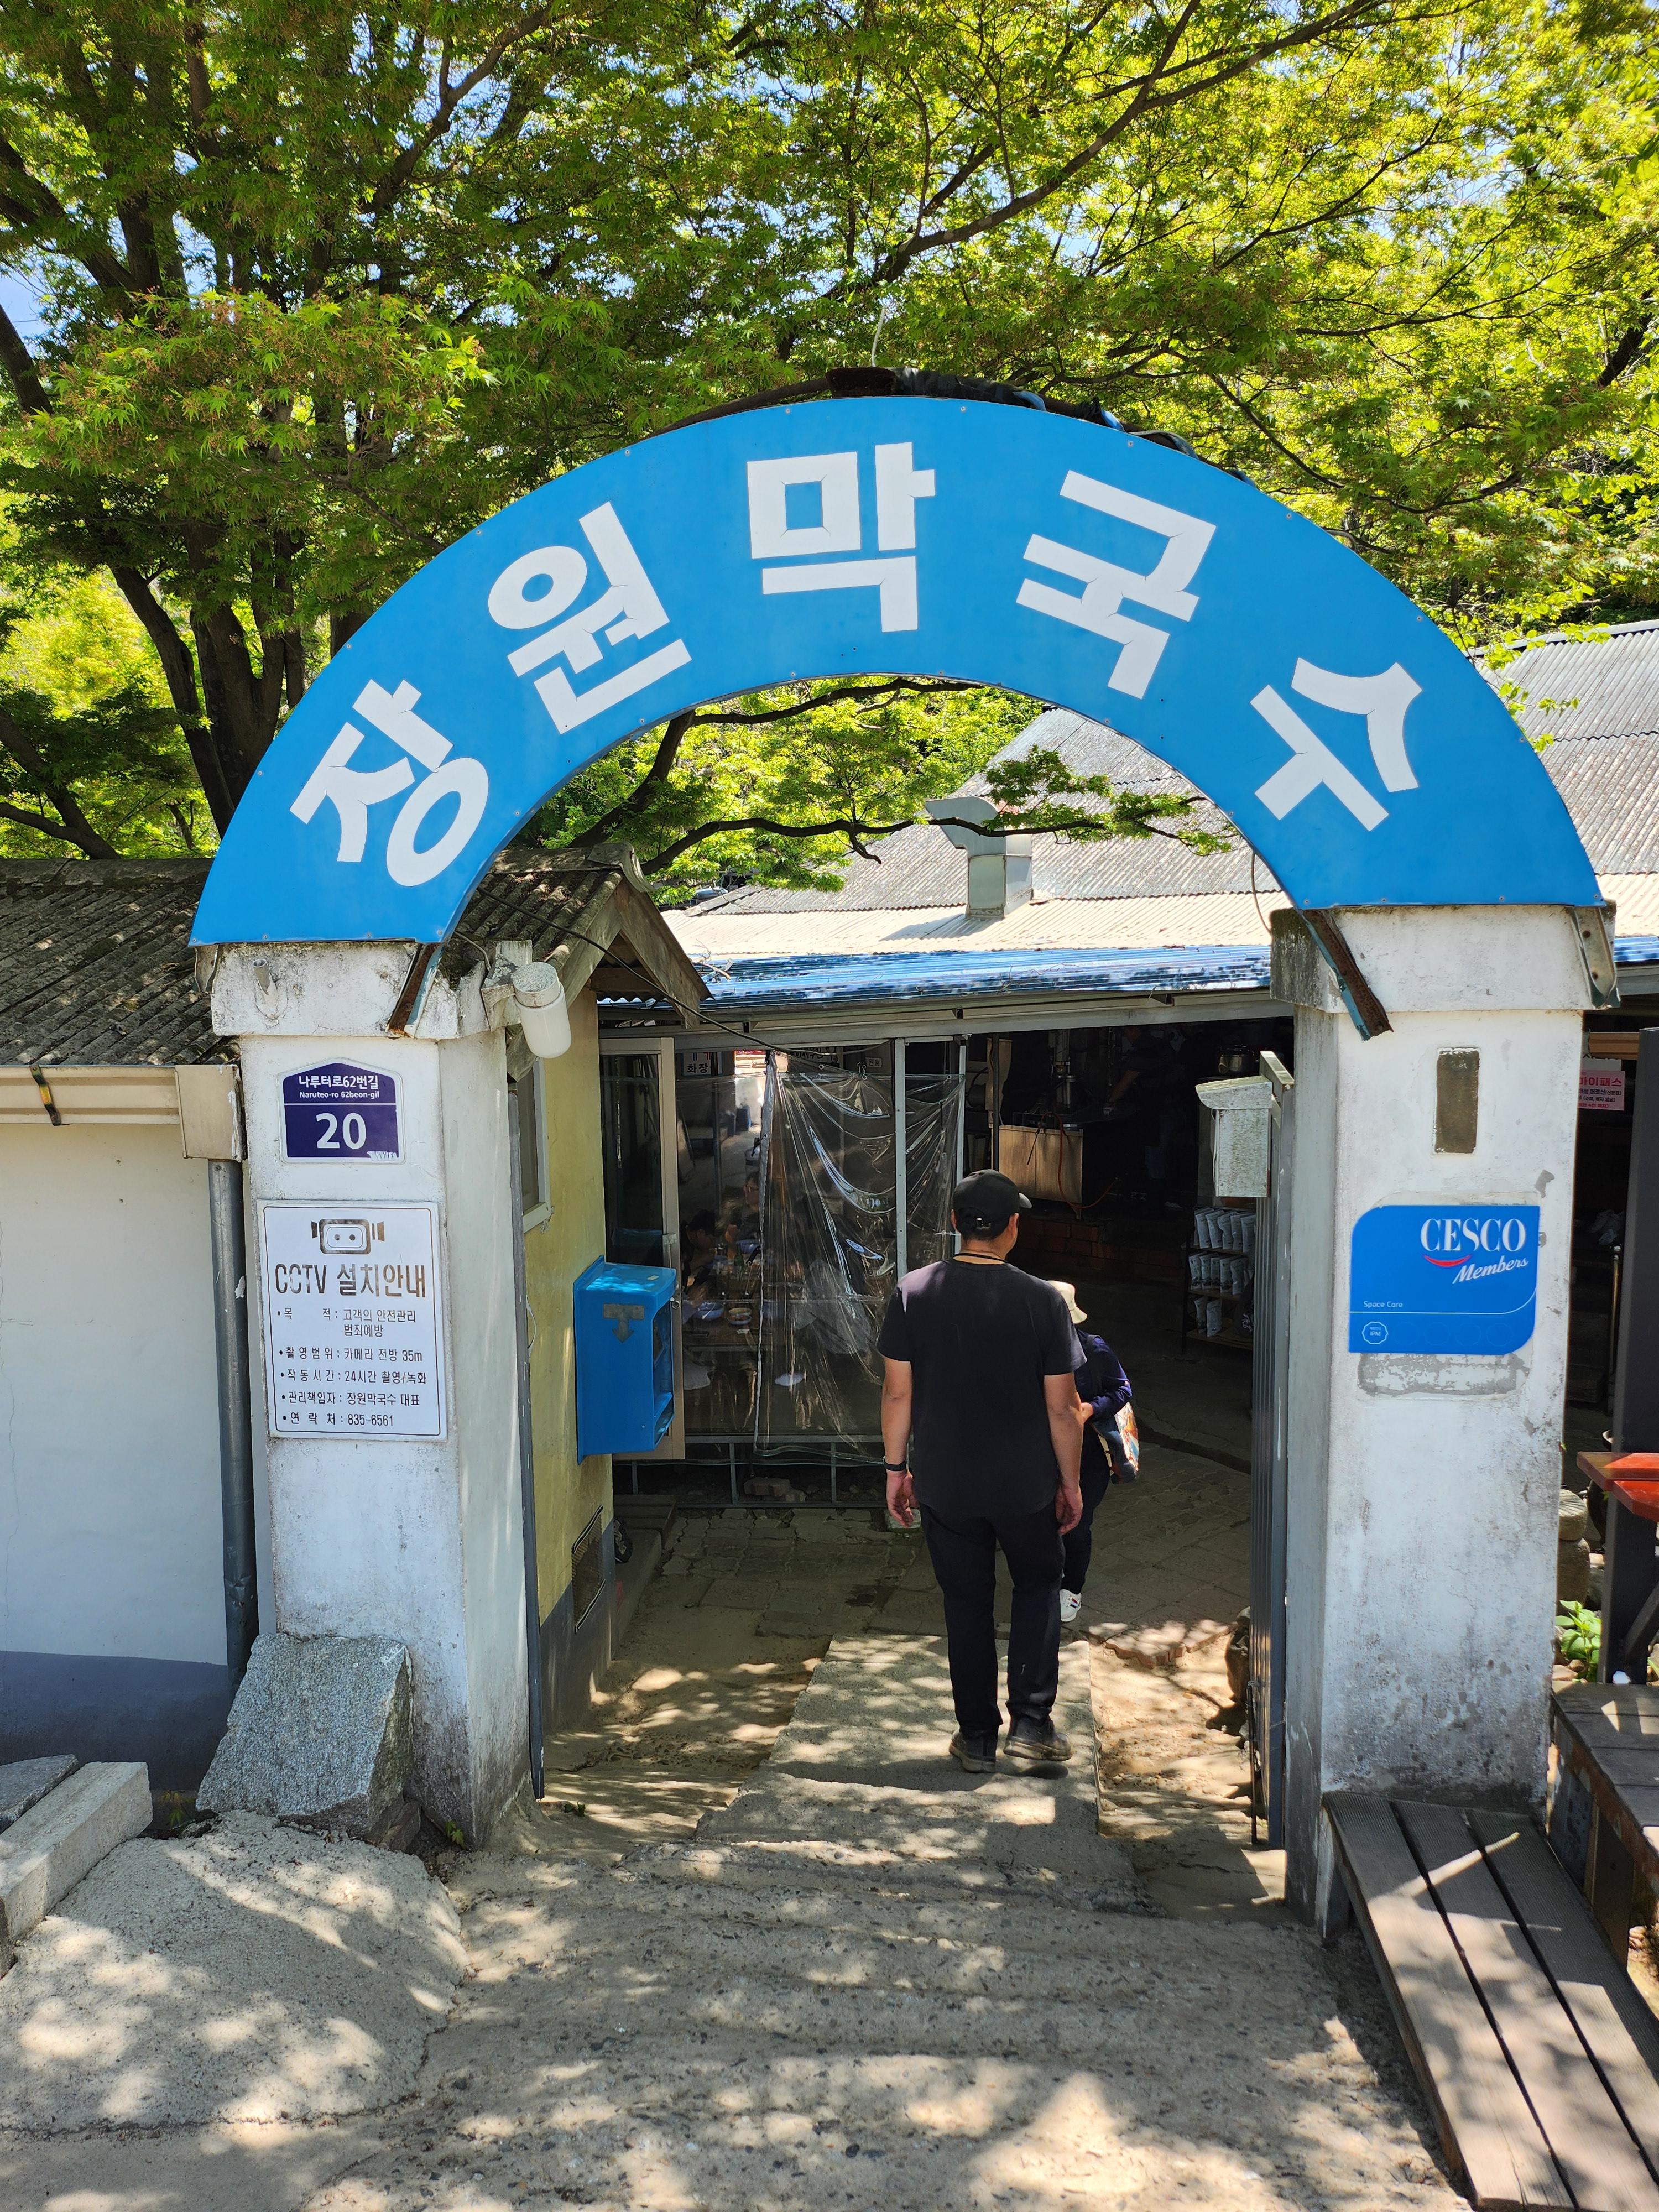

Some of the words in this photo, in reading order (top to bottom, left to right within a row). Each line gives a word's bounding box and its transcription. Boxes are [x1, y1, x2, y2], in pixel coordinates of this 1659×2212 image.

[291, 441, 1422, 887] 장원막국수
[687, 1063, 712, 1073] 화장
[299, 1075, 378, 1089] 나루터로62번길
[341, 1091, 379, 1099] 62beon-gil
[316, 1113, 366, 1149] 20
[1420, 1218, 1526, 1252] CESCO
[1452, 1255, 1529, 1284] Members
[275, 1264, 327, 1294] CCTV
[337, 1264, 425, 1297] 설치안내
[343, 1309, 372, 1322] 고객의
[377, 1310, 416, 1323] 안전관리
[345, 1324, 383, 1337] 범죄예방
[344, 1348, 373, 1360] 카메라
[378, 1349, 398, 1361] 전방
[402, 1350, 422, 1361] 35m
[345, 1370, 376, 1383] 24시간
[347, 1392, 396, 1405] 장원막국수
[400, 1394, 420, 1406] 대표
[348, 1414, 393, 1426] 835-6561
